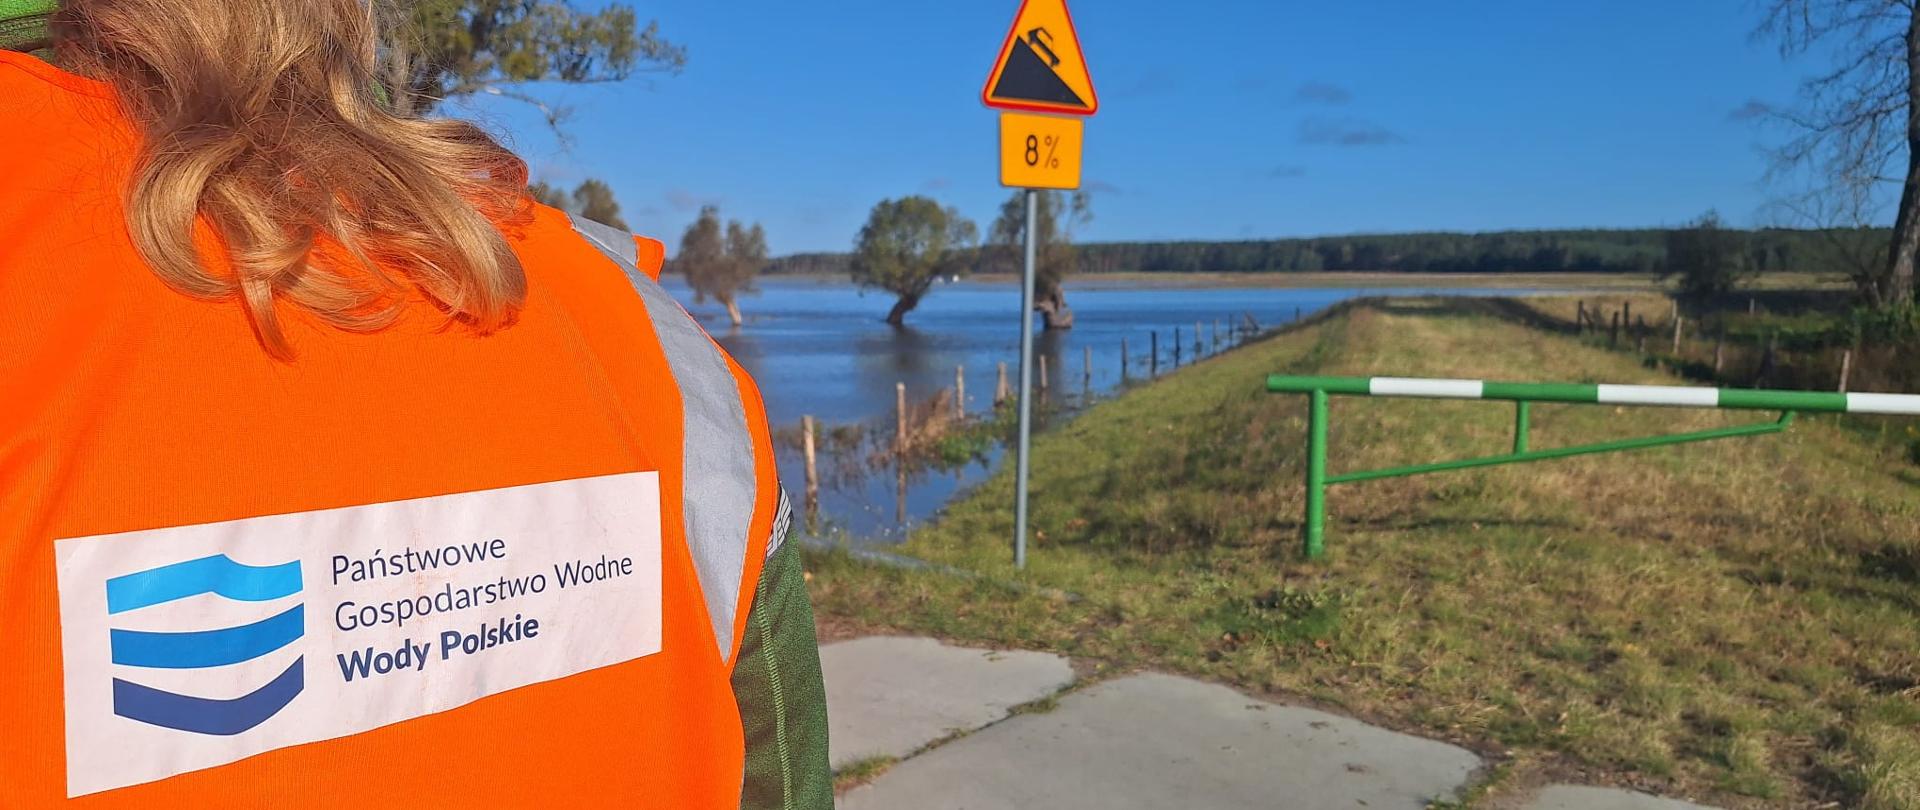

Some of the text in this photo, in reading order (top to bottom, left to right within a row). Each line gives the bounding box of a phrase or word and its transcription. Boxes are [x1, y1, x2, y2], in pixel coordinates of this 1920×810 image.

[331, 537, 506, 586] Państwowe
[335, 554, 633, 632] Gospodarstwo Wodne
[336, 613, 539, 682] Wody Polskie
